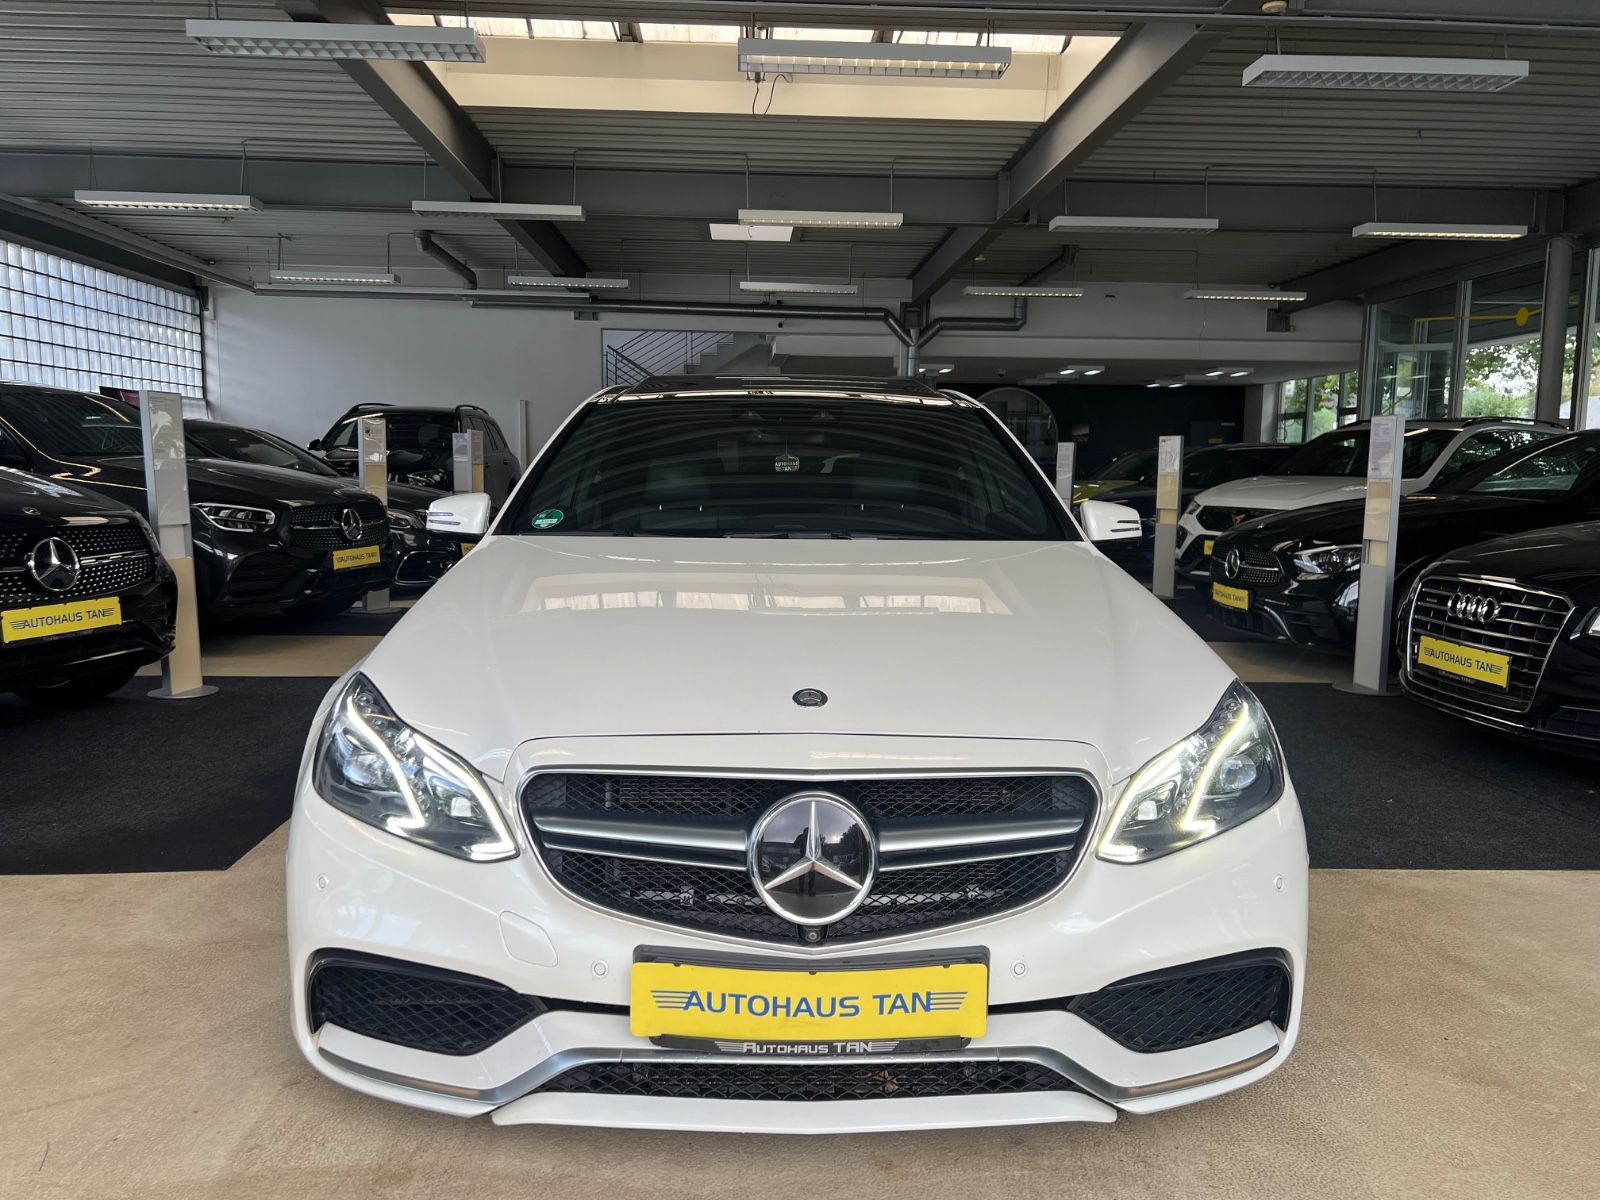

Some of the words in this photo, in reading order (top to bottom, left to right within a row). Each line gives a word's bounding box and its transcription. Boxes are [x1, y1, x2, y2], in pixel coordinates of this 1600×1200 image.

[23, 612, 83, 628] AUTOHAUS
[86, 609, 105, 619] TAN
[1429, 649, 1472, 667] AUTOHAUS
[1475, 660, 1492, 672] TAN
[683, 990, 860, 1018] AUTOHAUS
[872, 991, 932, 1015] TAN
[833, 1041, 872, 1053] TAN
